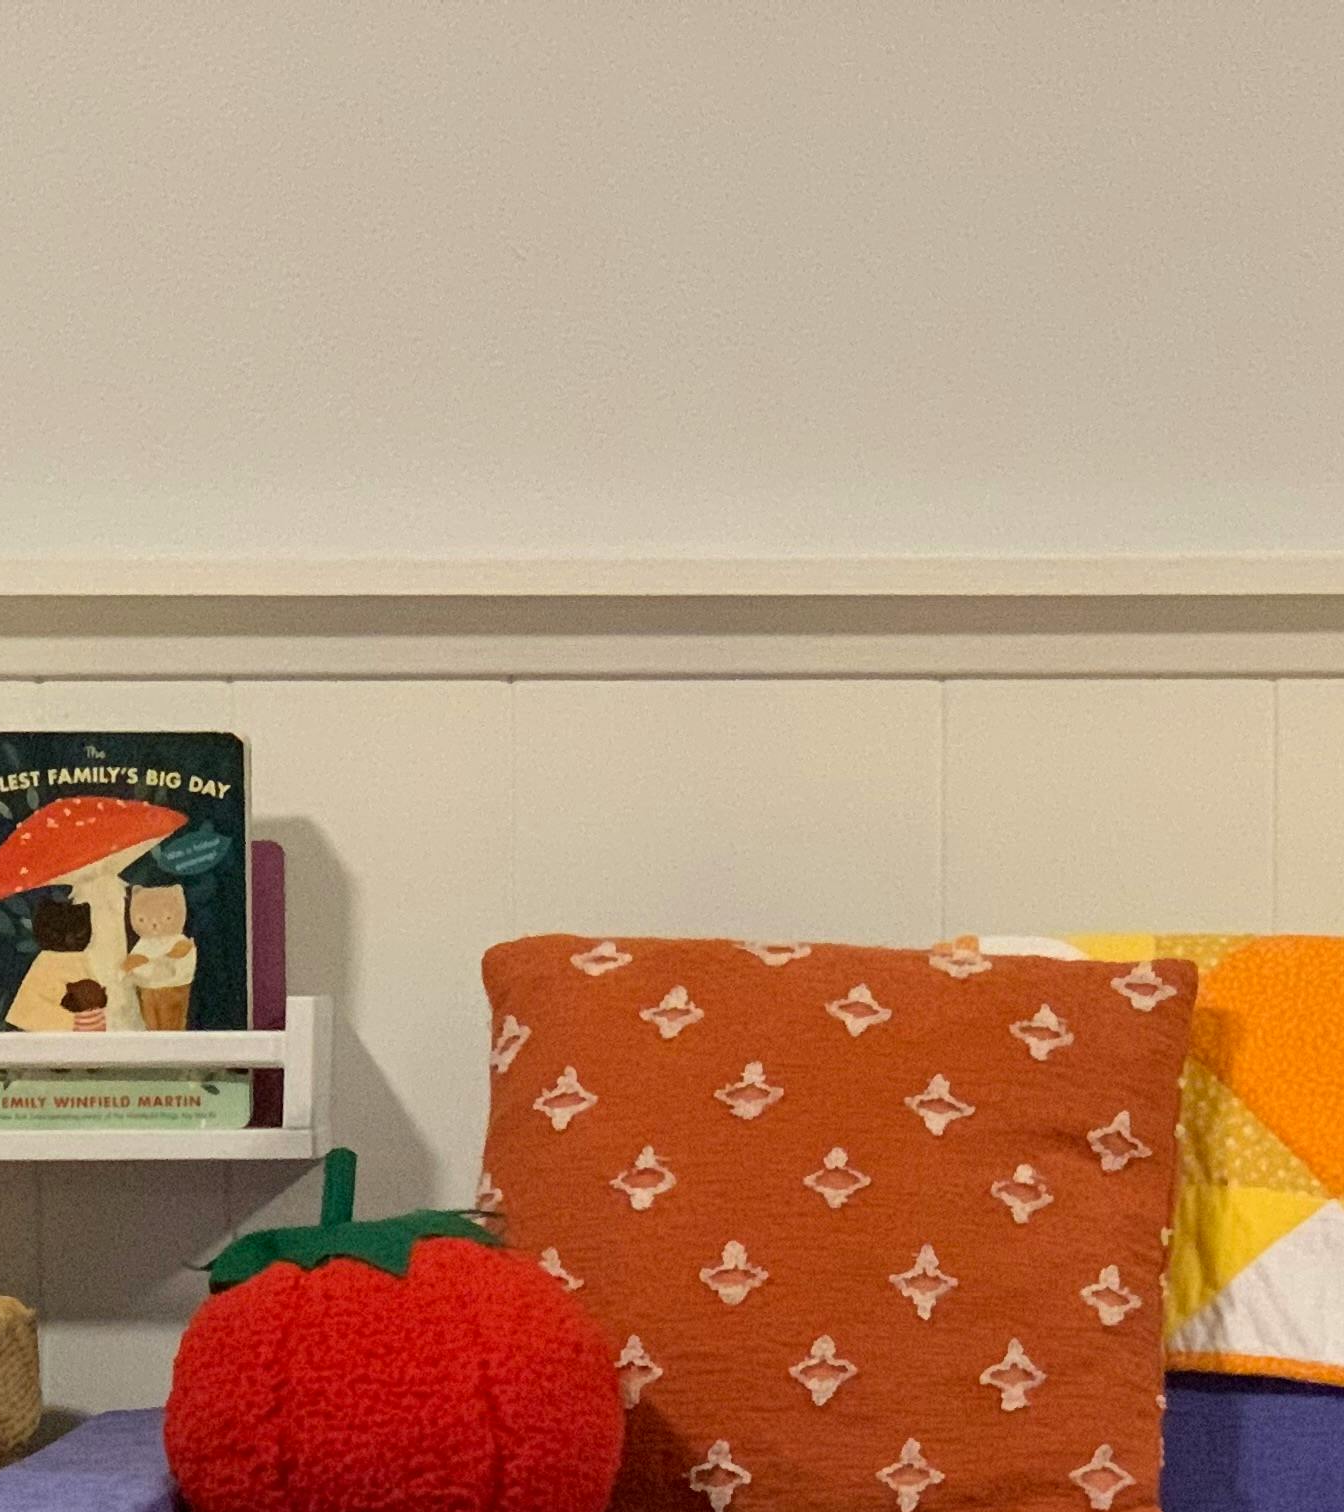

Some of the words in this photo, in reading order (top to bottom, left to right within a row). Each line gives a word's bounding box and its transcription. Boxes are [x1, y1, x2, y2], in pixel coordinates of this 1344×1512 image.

[84, 745, 105, 759] The
[47, 766, 139, 786] FAMILY'S
[146, 769, 182, 789] BIG
[189, 775, 231, 800] DAY
[1, 1096, 46, 1109] EMILY
[54, 1096, 130, 1109] WINFIELD
[137, 1095, 202, 1108] MARTIN
